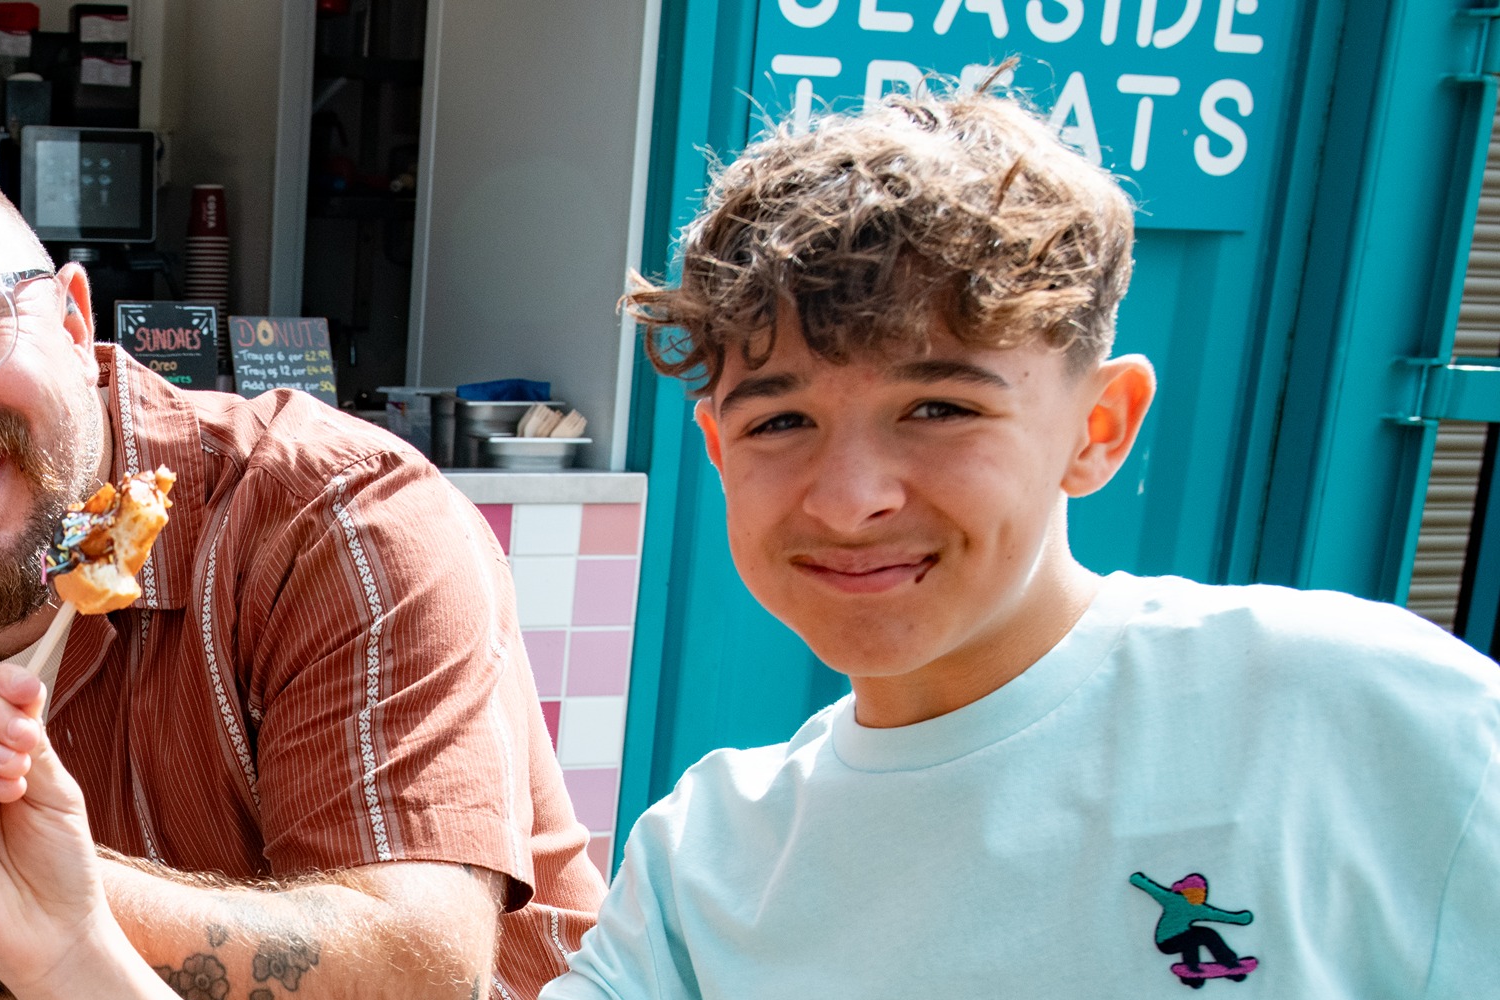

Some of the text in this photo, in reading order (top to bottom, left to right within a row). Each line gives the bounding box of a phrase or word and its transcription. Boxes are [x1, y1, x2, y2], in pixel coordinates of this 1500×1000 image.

[778, 0, 1264, 54] ASIDE
[771, 53, 1254, 176] TATS
[207, 195, 216, 228] COSTA
[134, 326, 202, 352] SUNDAES
[149, 359, 178, 372] Oreo
[264, 353, 275, 363] of
[277, 351, 285, 361] 6
[288, 353, 303, 363] for
[267, 367, 278, 379] of
[280, 365, 291, 376] 12
[292, 367, 306, 377] for
[241, 380, 266, 391] Add
[304, 381, 319, 392] for
